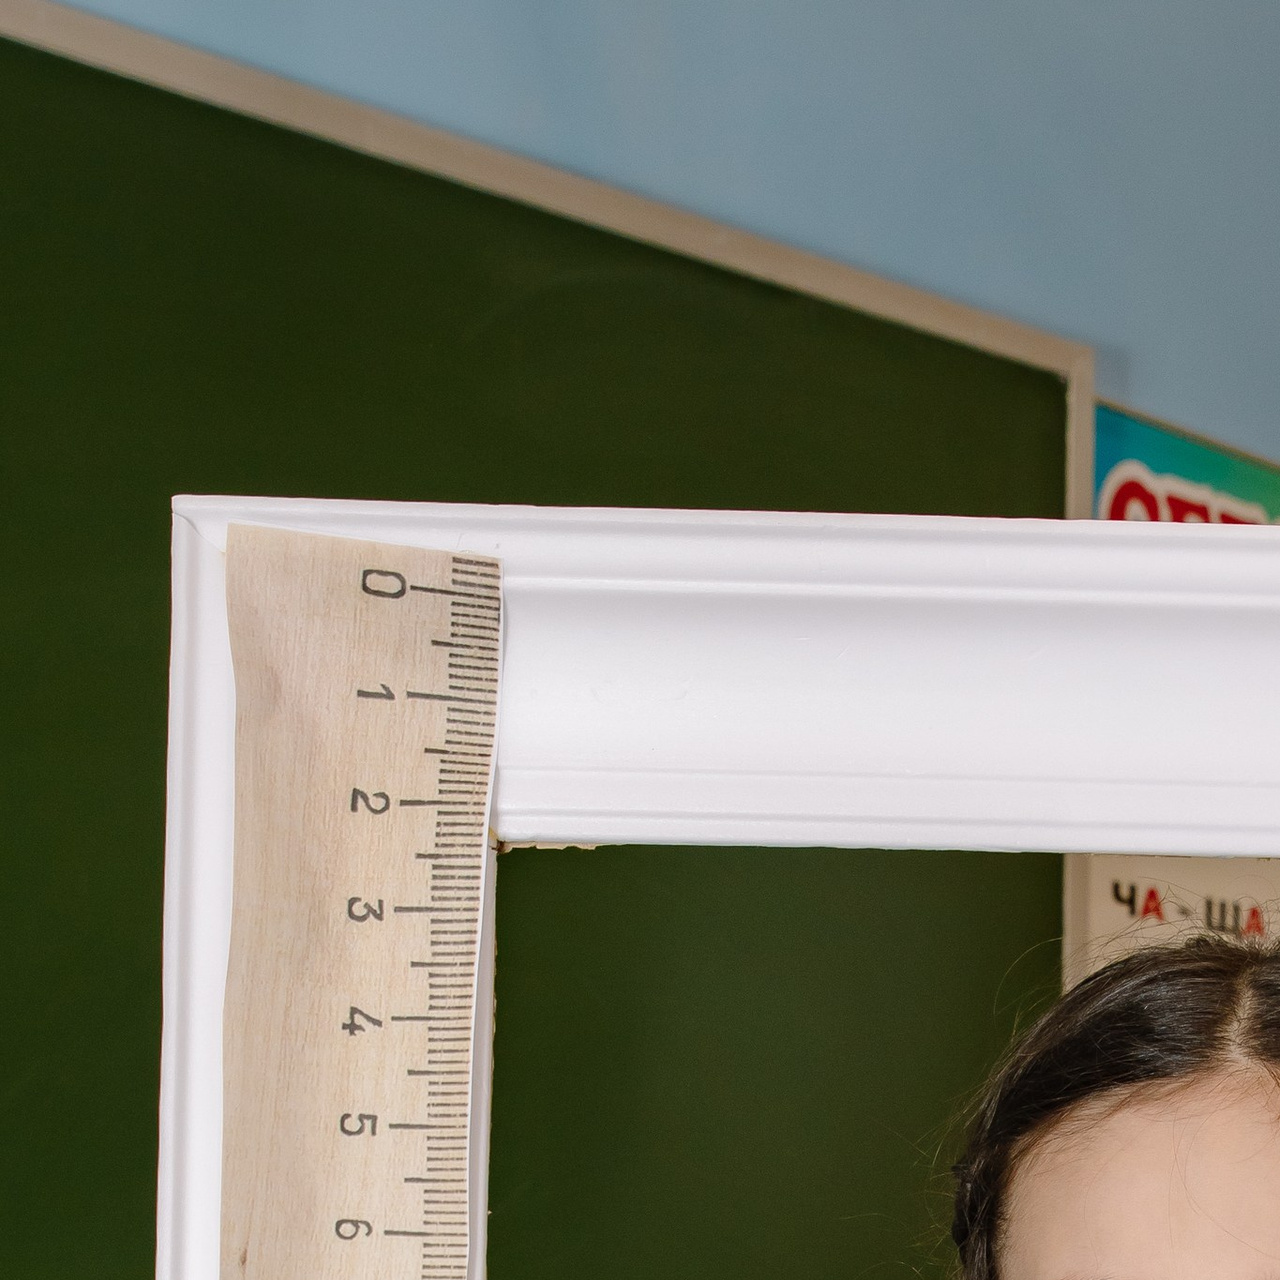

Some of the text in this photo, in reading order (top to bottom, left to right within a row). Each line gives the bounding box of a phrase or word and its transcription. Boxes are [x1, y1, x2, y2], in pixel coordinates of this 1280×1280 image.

[362, 569, 406, 598] 0
[357, 683, 396, 700] 1
[350, 787, 391, 813] 2
[347, 897, 384, 922] 3
[1112, 878, 1166, 922] ЧА
[341, 1006, 383, 1036] 4
[339, 1112, 378, 1137] 5
[334, 1217, 373, 1241] 6
